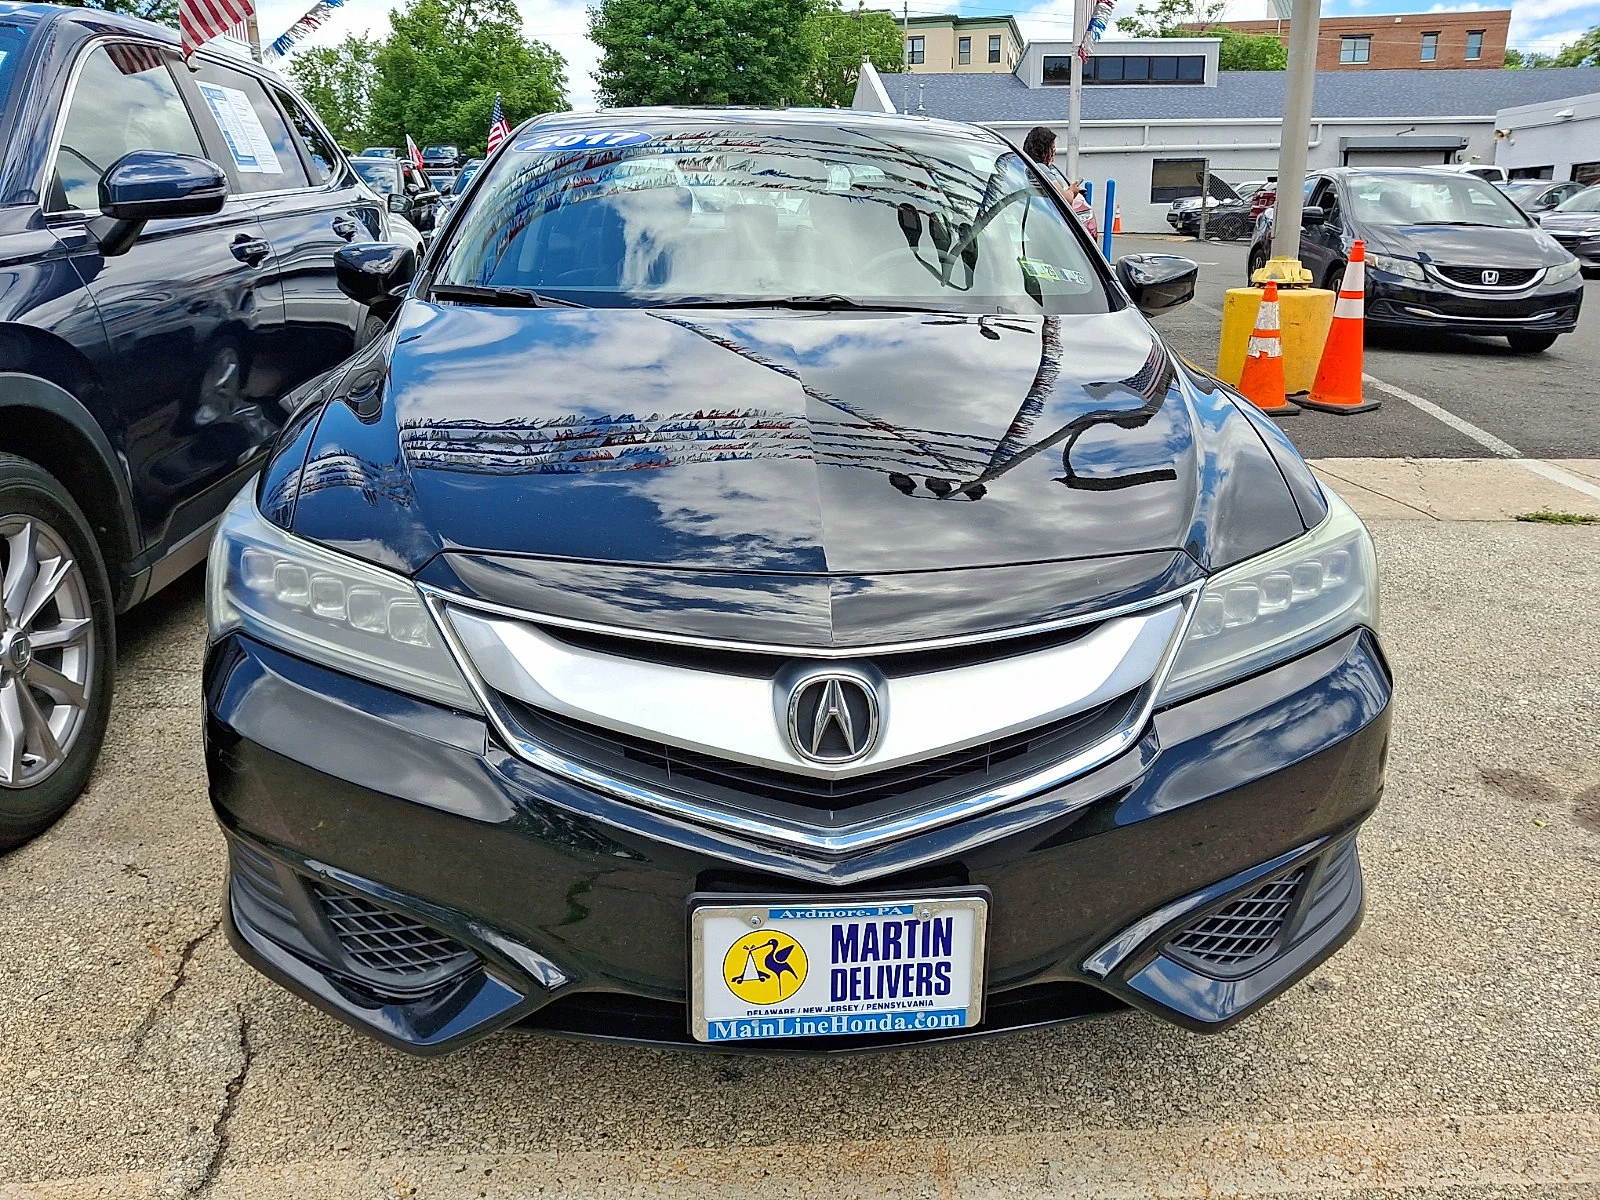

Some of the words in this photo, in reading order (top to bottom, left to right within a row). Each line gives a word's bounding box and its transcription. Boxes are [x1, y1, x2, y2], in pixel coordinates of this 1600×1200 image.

[523, 132, 641, 151] 2017
[877, 905, 903, 916] PA
[831, 917, 953, 964] MARTIN
[830, 962, 952, 1002] DELIVERS
[802, 1006, 823, 1014] NEW
[825, 1004, 859, 1013] JERSEY
[866, 999, 934, 1011] PENNSYLVANIA
[713, 1011, 960, 1040] MainLineHonda.com
